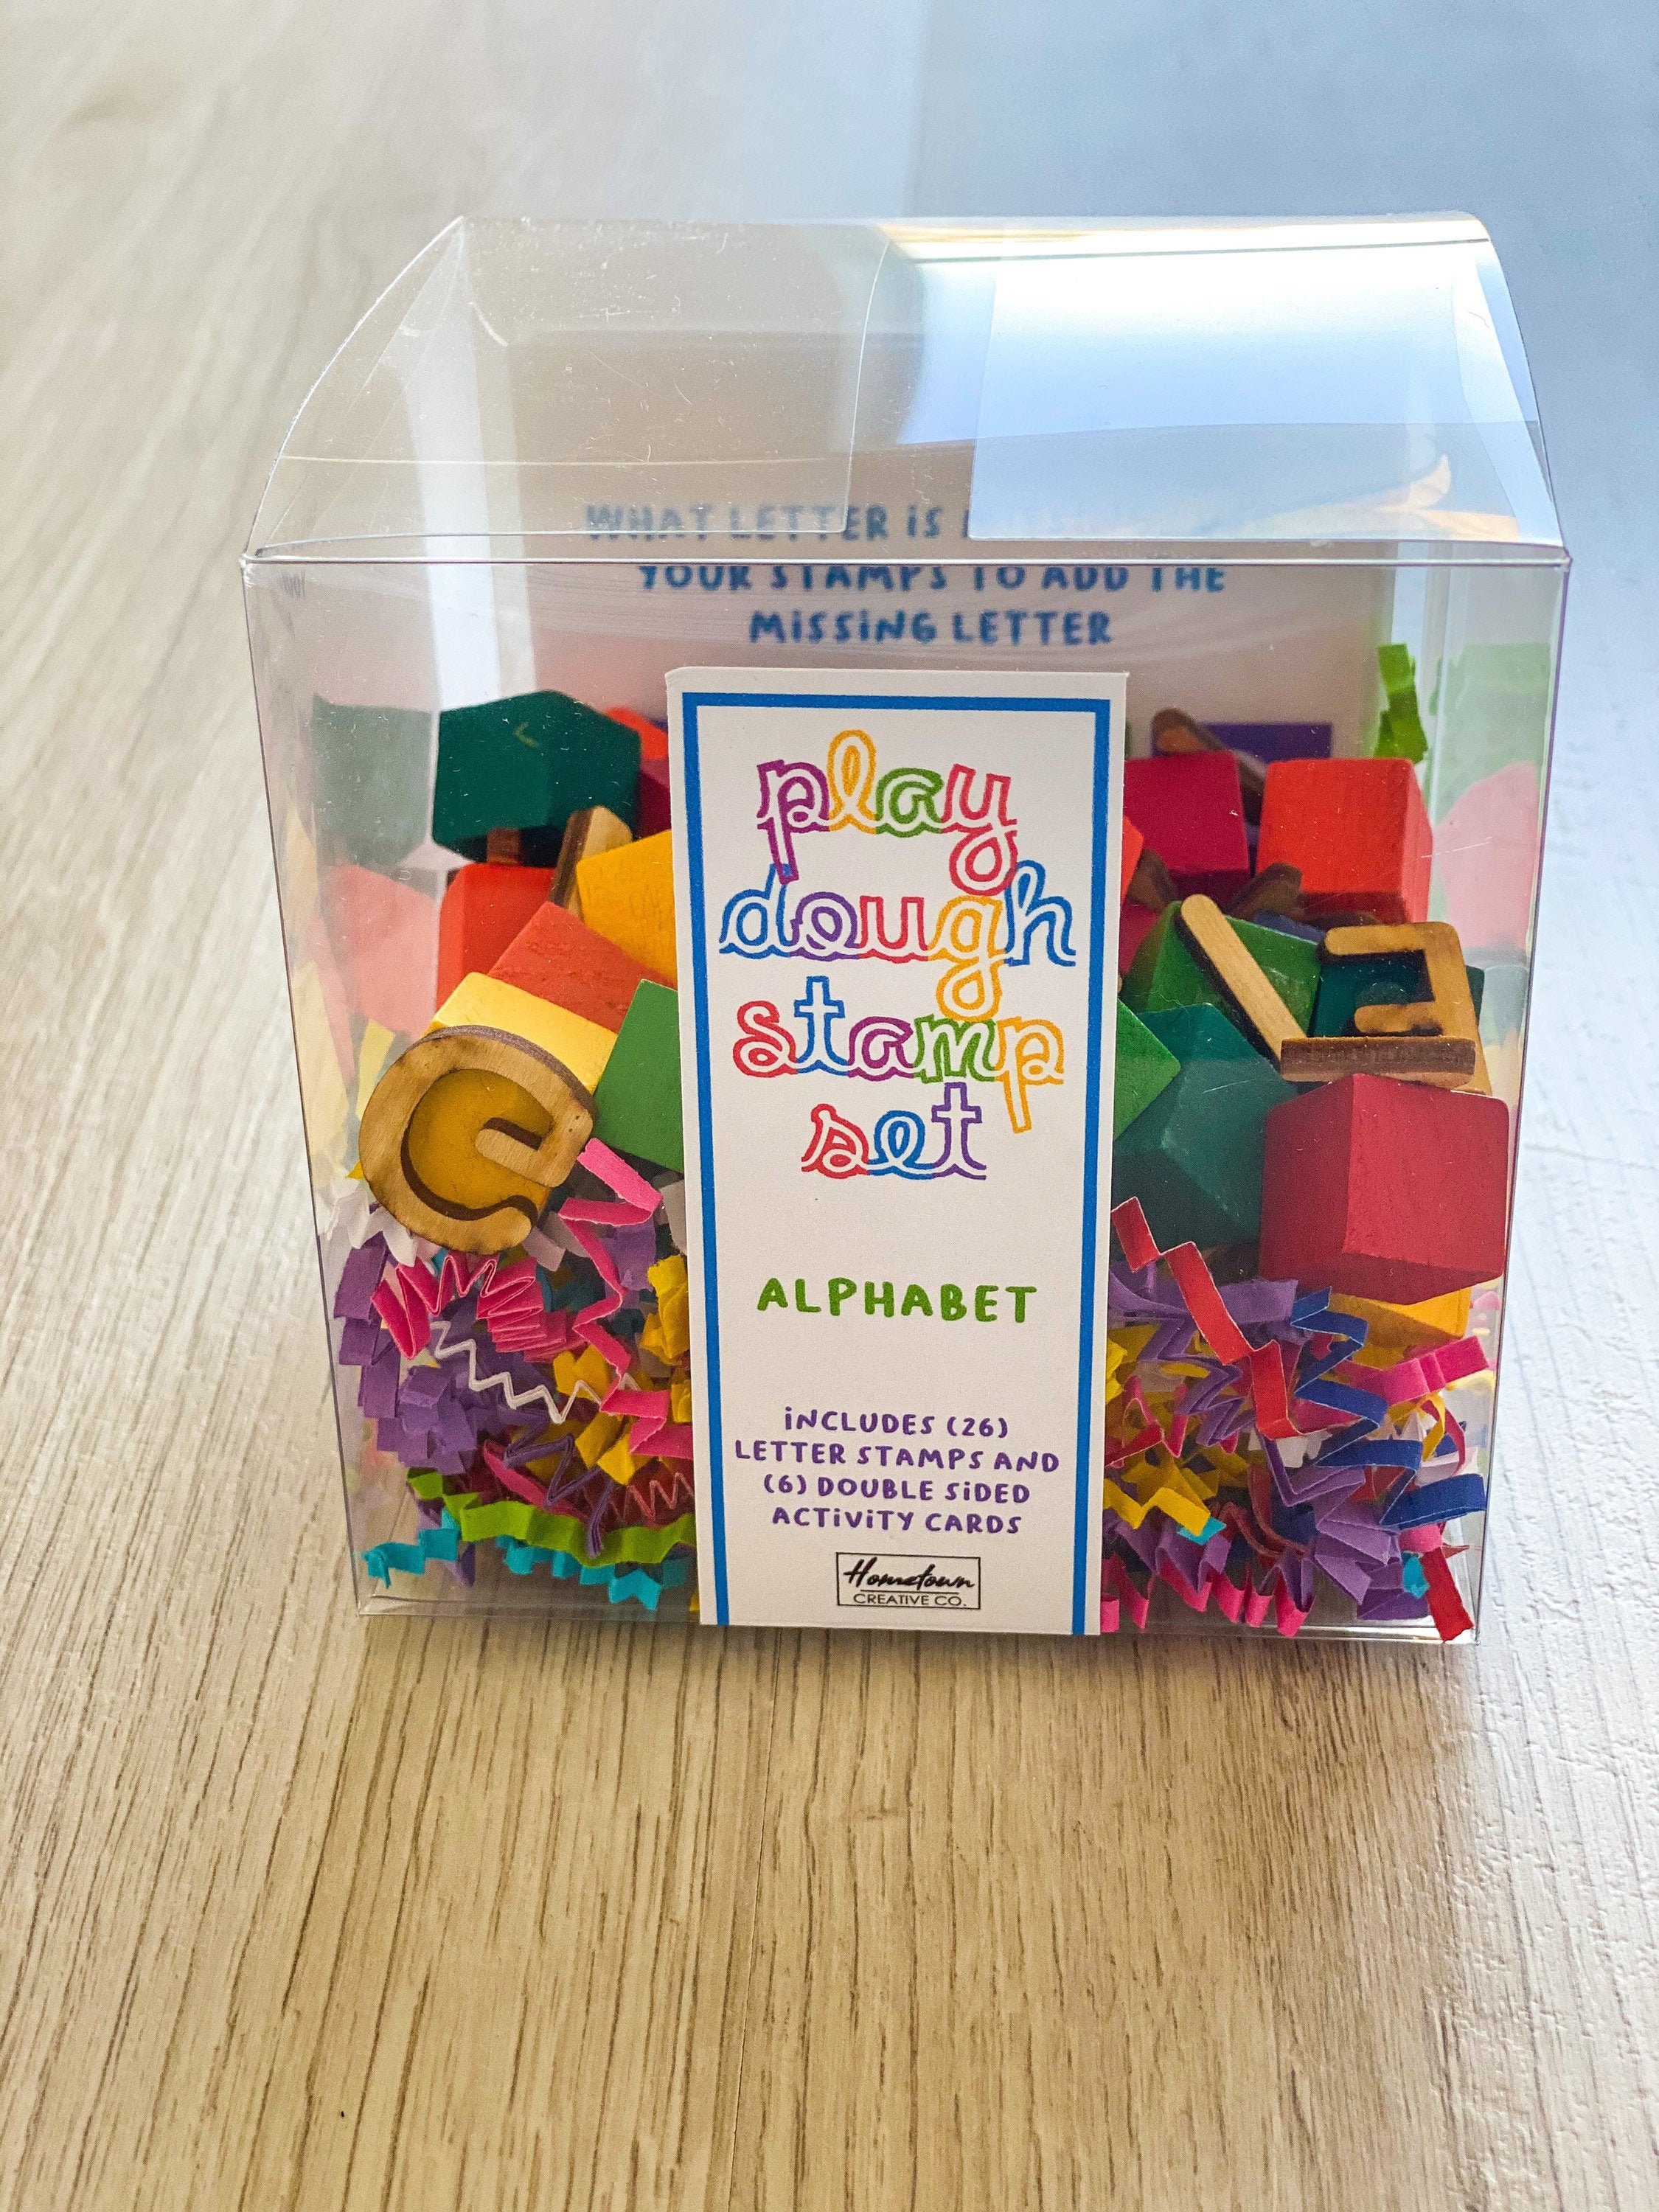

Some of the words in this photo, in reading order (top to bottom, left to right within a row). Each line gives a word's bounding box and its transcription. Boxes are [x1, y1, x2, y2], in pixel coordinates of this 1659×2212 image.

[586, 503, 713, 541] WHAT
[730, 504, 888, 540] LETTER
[639, 565, 753, 591] YOUR
[771, 565, 948, 591] STAMPS
[974, 565, 1026, 591] TO
[1041, 565, 1129, 591] ADD
[1152, 565, 1226, 591] THE
[952, 609, 1112, 646] LETTER
[757, 729, 1018, 894] play
[719, 860, 1076, 1022] dough
[733, 975, 1064, 1133] stamp
[801, 1082, 987, 1180] set
[757, 1277, 1037, 1324] ALPHABET
[946, 1415, 1009, 1439] (26)
[734, 1440, 846, 1465] LETTER
[857, 1446, 984, 1470] STAMPS
[993, 1452, 1060, 1473] AND
[764, 1473, 807, 1496] (6)
[818, 1477, 933, 1500] DOUBLE
[925, 1512, 1022, 1534] CARDS
[843, 1557, 975, 1590] Hometown
[853, 1593, 929, 1605] CREATIVE
[935, 1596, 967, 1606] CO.
